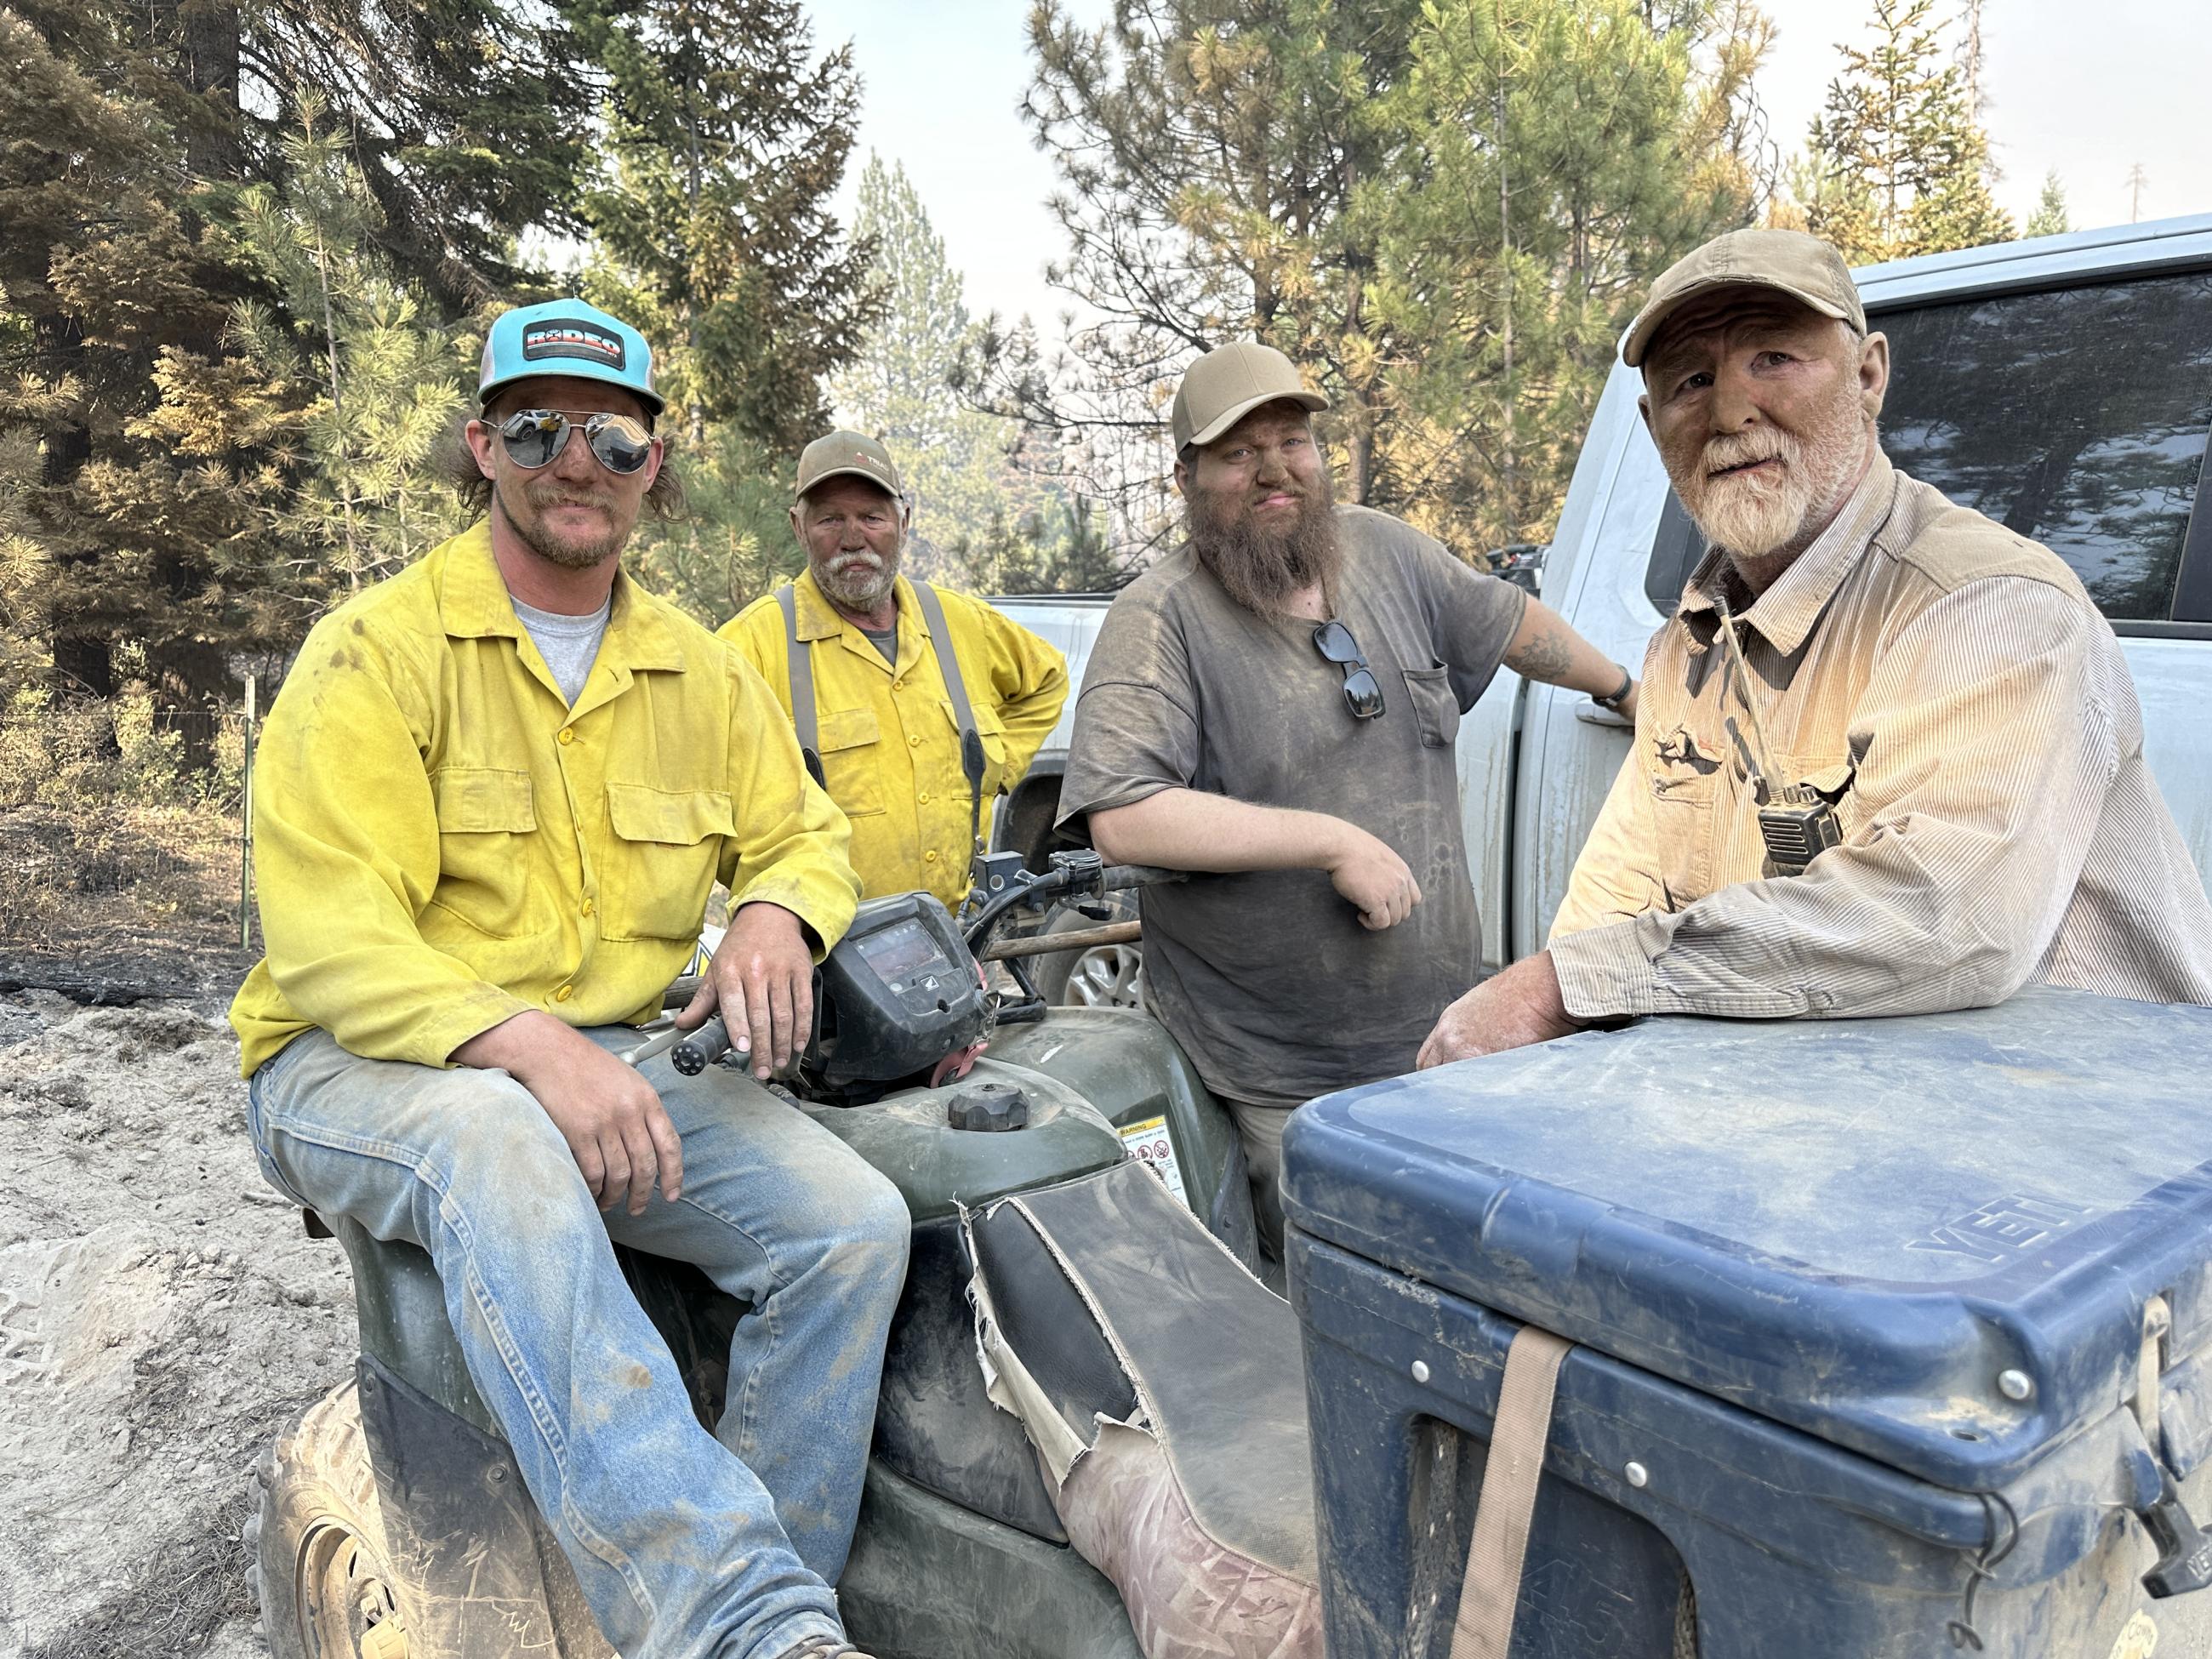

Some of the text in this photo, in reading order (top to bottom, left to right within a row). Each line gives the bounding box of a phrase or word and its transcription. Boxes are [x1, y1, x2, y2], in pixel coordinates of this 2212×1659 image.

[527, 328, 621, 355] RODEO
[1120, 1123, 1147, 1136] WARNING
[1903, 1190, 2094, 1263] YETI
